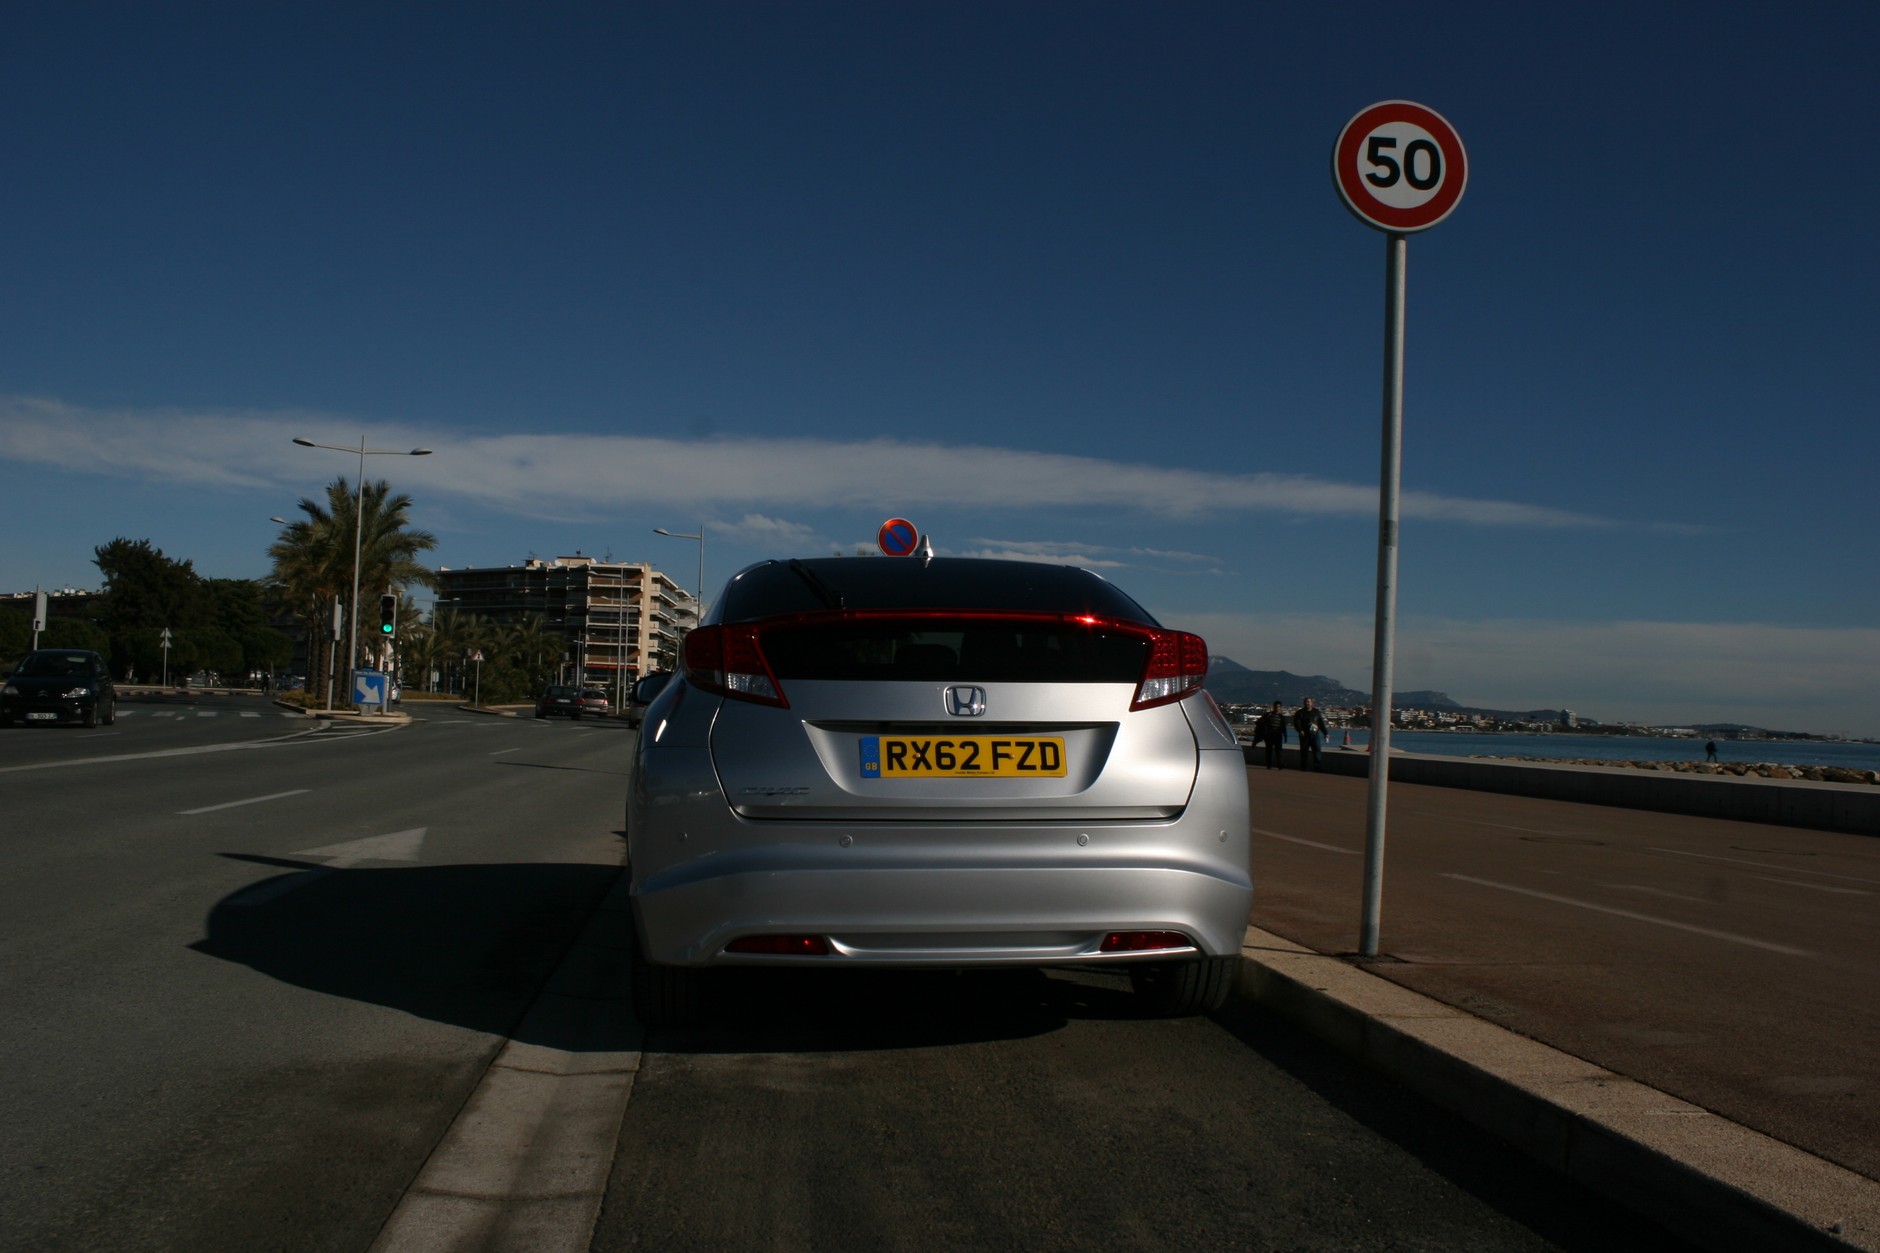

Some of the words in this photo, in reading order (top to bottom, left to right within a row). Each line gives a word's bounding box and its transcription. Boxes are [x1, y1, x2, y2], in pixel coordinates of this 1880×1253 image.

[1365, 136, 1441, 190] 50
[865, 762, 878, 771] GB
[886, 741, 981, 771] RX62
[991, 741, 1060, 771] FZD
